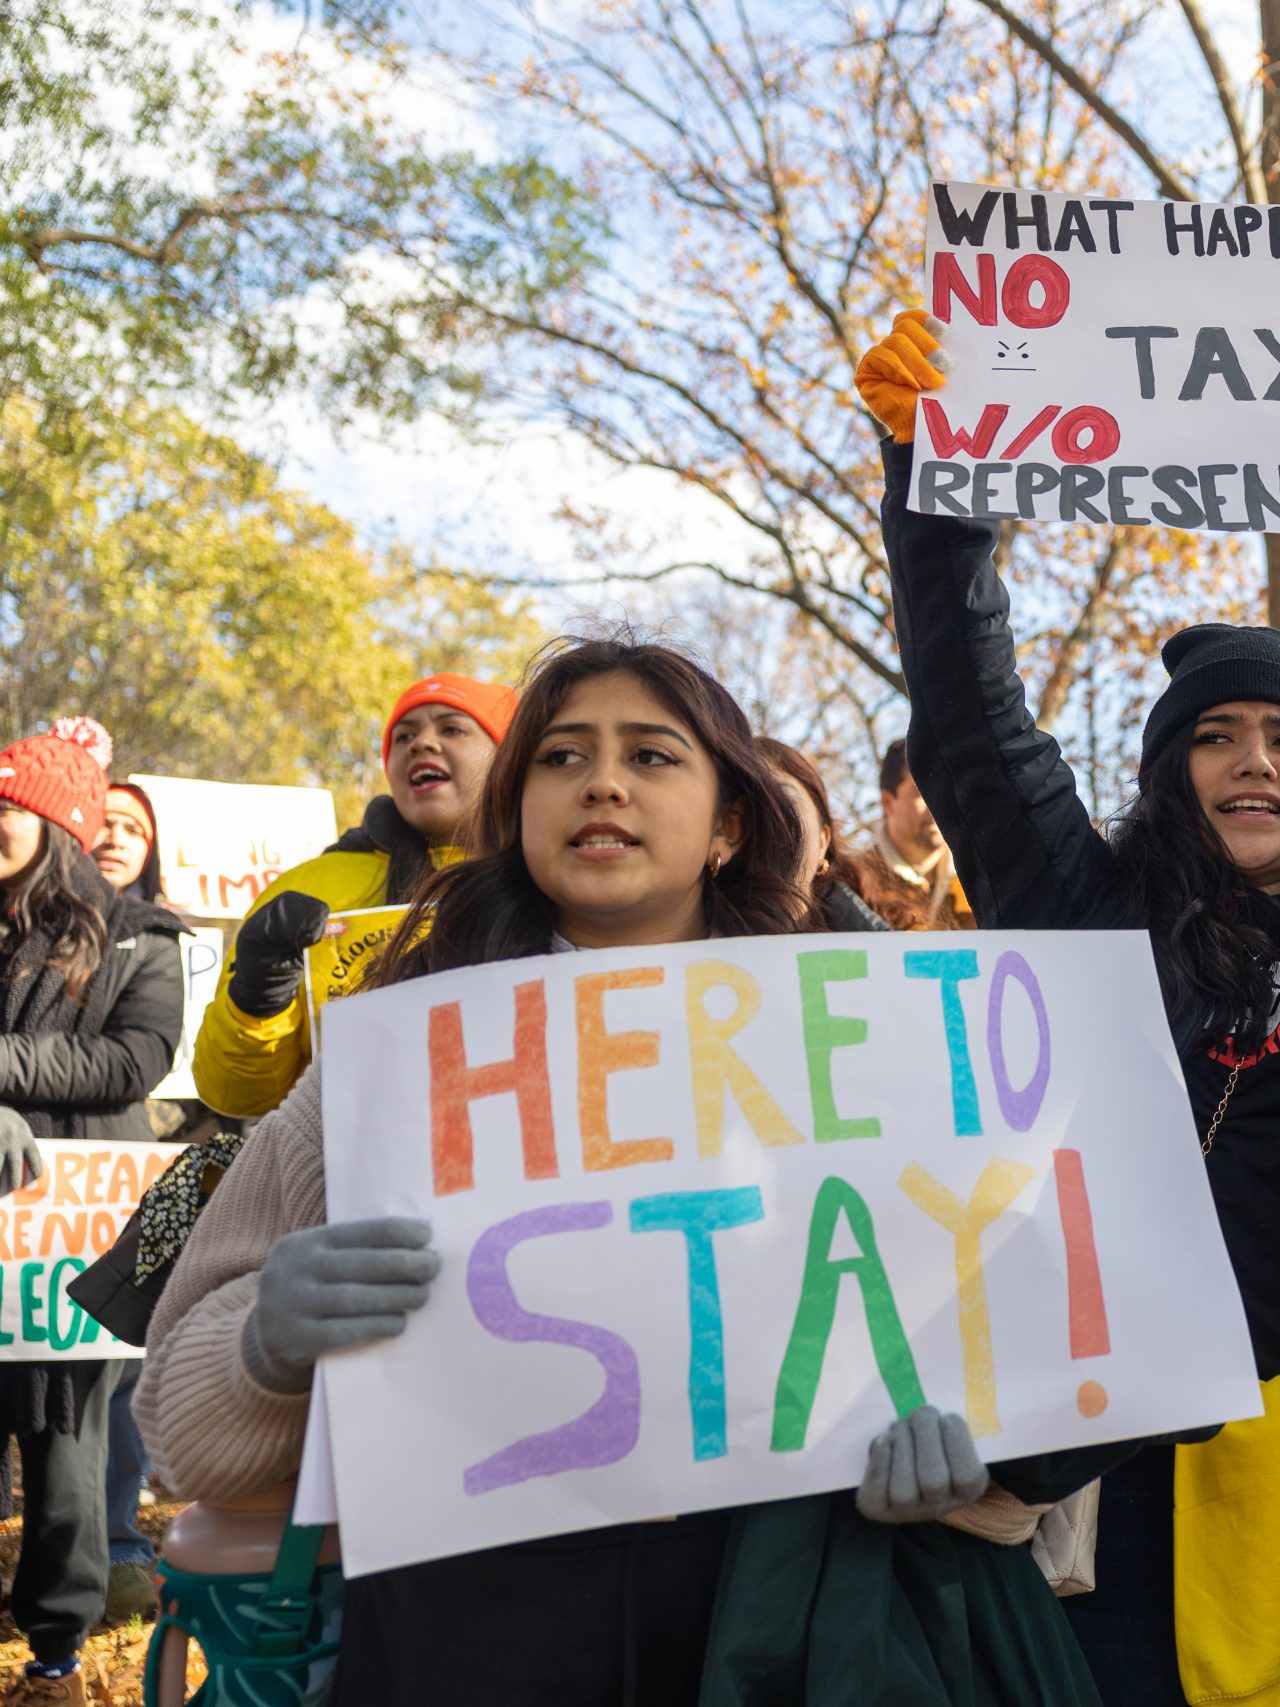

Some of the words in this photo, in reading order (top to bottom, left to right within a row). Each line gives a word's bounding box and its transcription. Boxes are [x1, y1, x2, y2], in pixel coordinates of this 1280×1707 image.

[932, 182, 1134, 254] WHAT
[932, 251, 1070, 329] NO
[921, 398, 1121, 463] W/O
[427, 950, 882, 1196] HERE
[902, 949, 1050, 1137] TO
[462, 1148, 1111, 1498] STAY!
